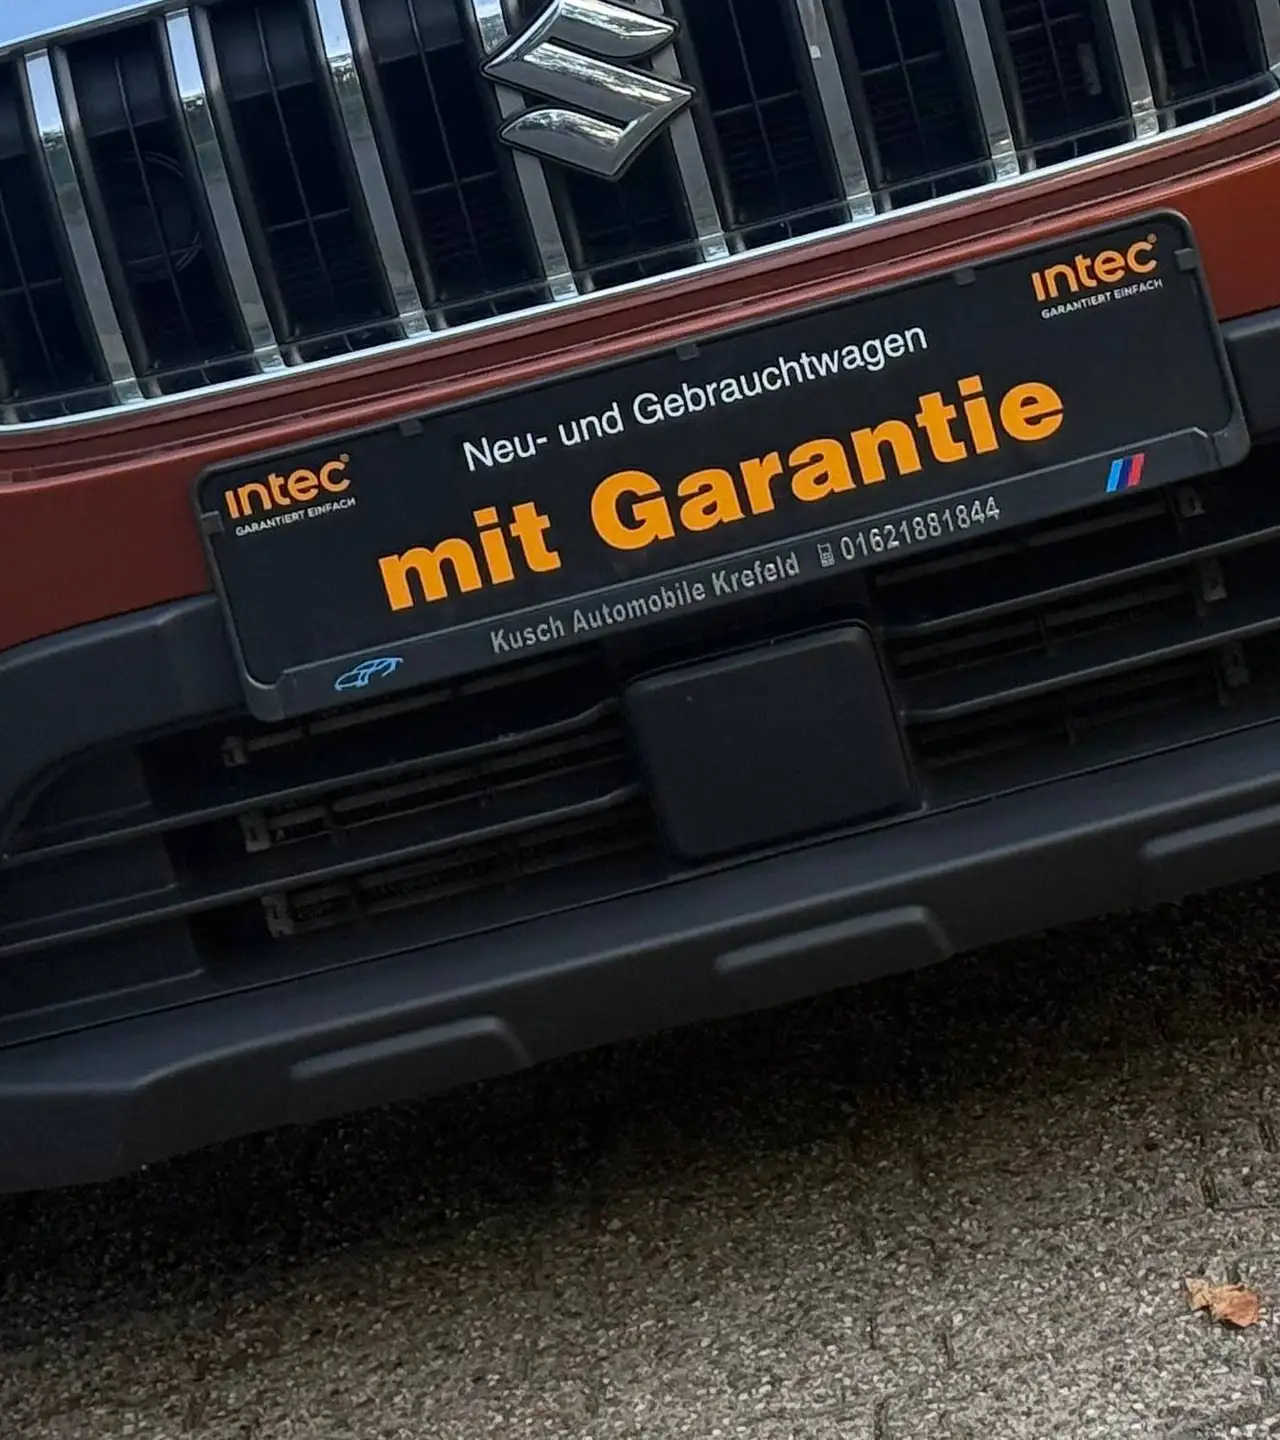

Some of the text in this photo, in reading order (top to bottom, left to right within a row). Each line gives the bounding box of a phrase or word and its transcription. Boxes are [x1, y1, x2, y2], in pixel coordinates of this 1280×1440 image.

[1040, 277, 1164, 320] GARANTIERT EINFACH
[462, 325, 928, 472] Neu- und Gebrauchtwagen
[235, 496, 357, 537] GARANTIERT EINFACH
[378, 375, 1065, 611] mit Garantie
[490, 496, 1001, 654] Kusch Automobile Krefeld 01621881844
